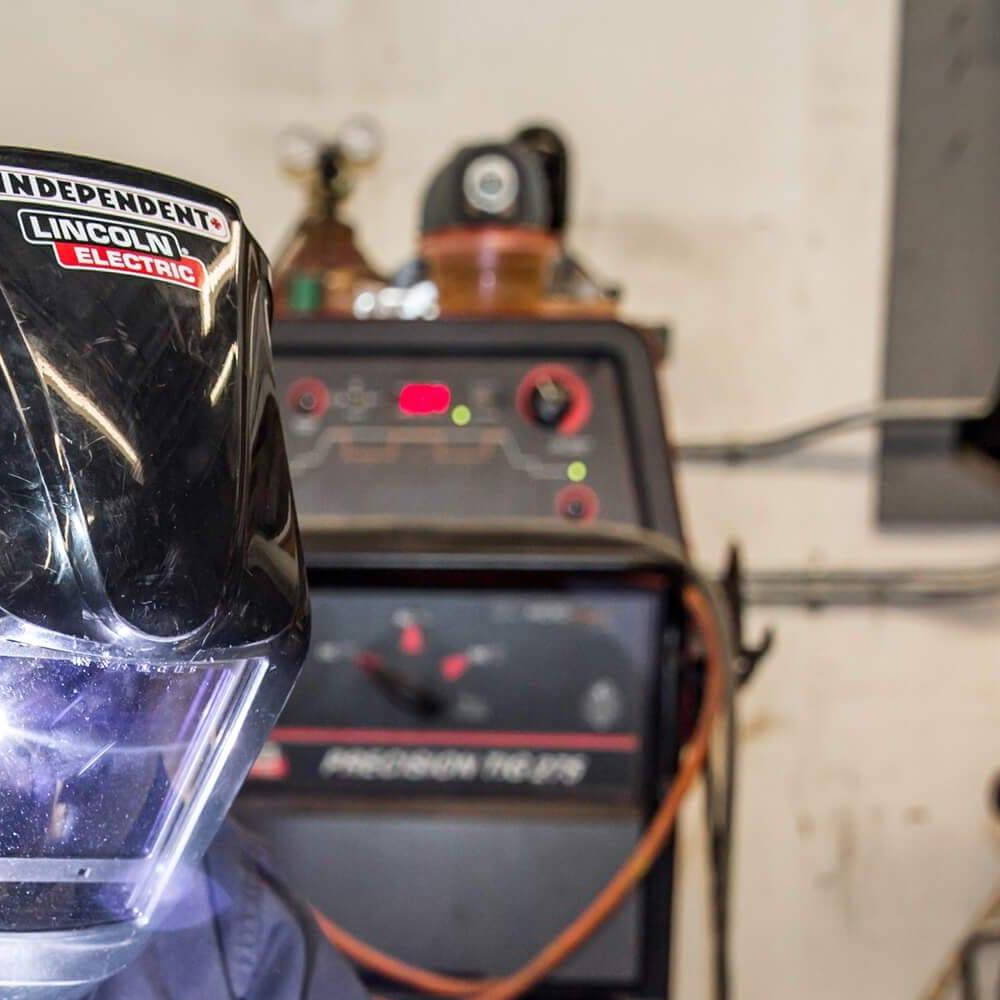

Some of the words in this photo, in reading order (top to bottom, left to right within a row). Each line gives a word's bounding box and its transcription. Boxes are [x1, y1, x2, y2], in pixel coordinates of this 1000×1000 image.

[28, 215, 170, 256] LINCOLN
[75, 246, 196, 283] ELECTRIC
[319, 747, 478, 781] PRECISION
